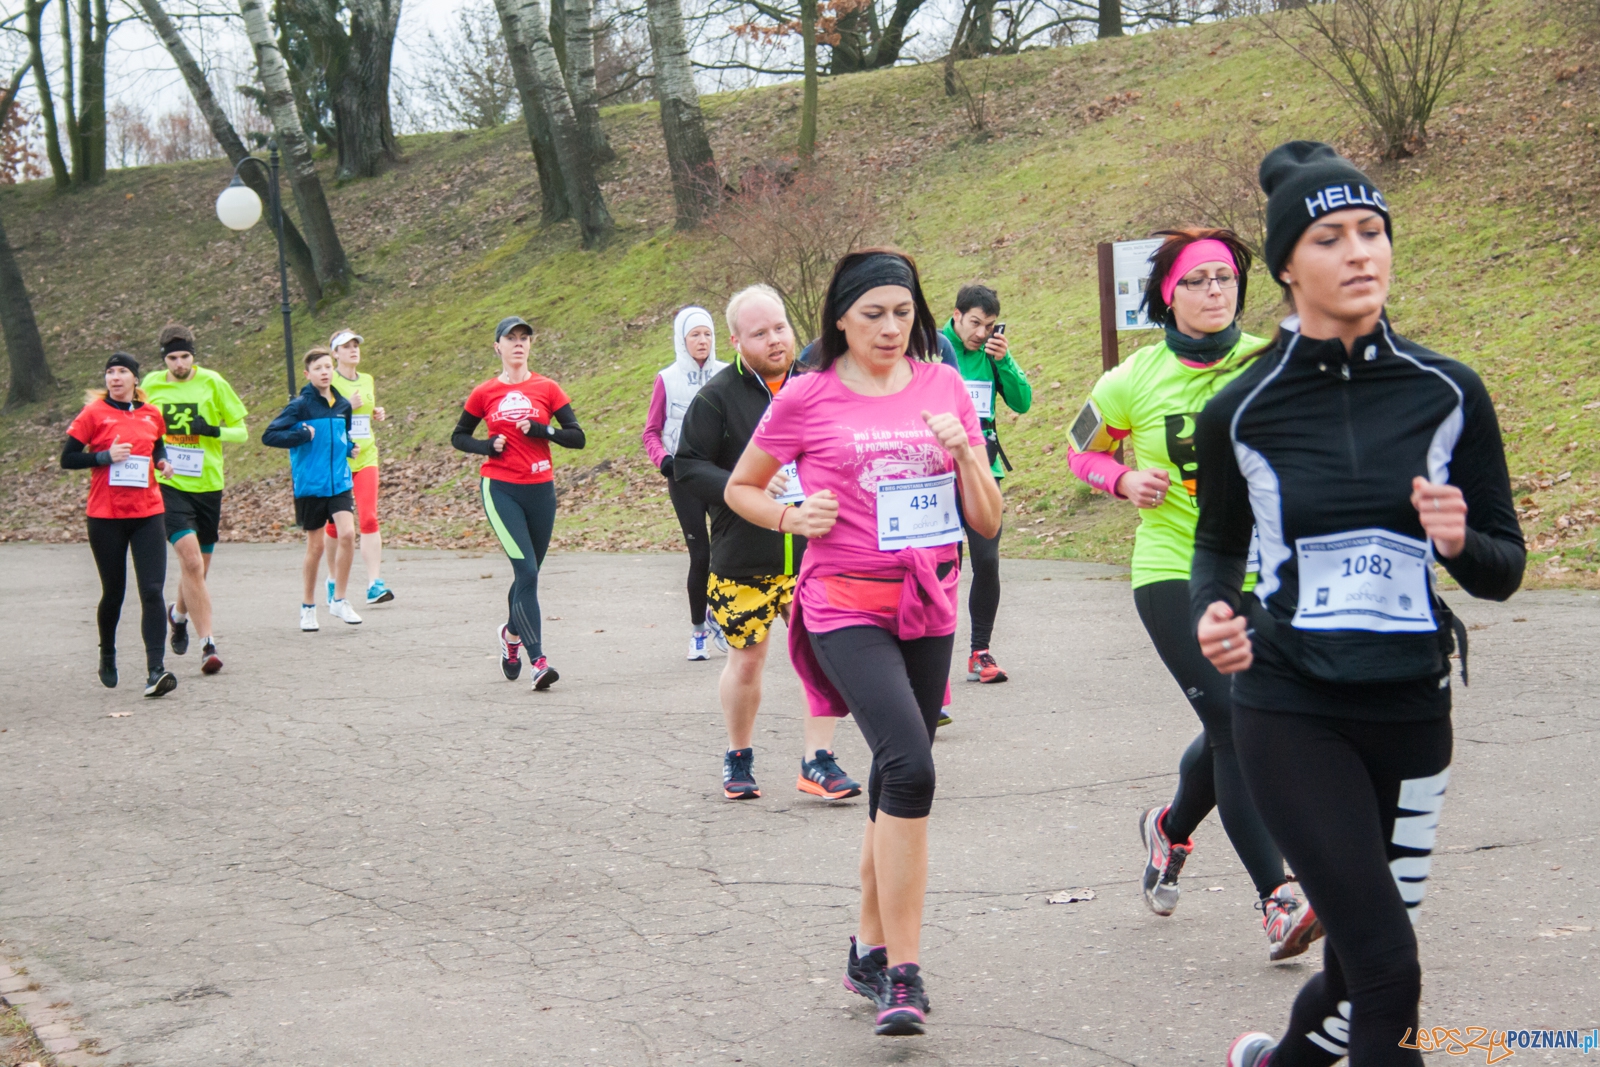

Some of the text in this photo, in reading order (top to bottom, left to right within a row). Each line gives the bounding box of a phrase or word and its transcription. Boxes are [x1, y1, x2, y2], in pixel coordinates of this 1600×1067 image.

[177, 453, 191, 461] 478
[910, 493, 938, 510] 434
[1341, 554, 1393, 580] 1082
